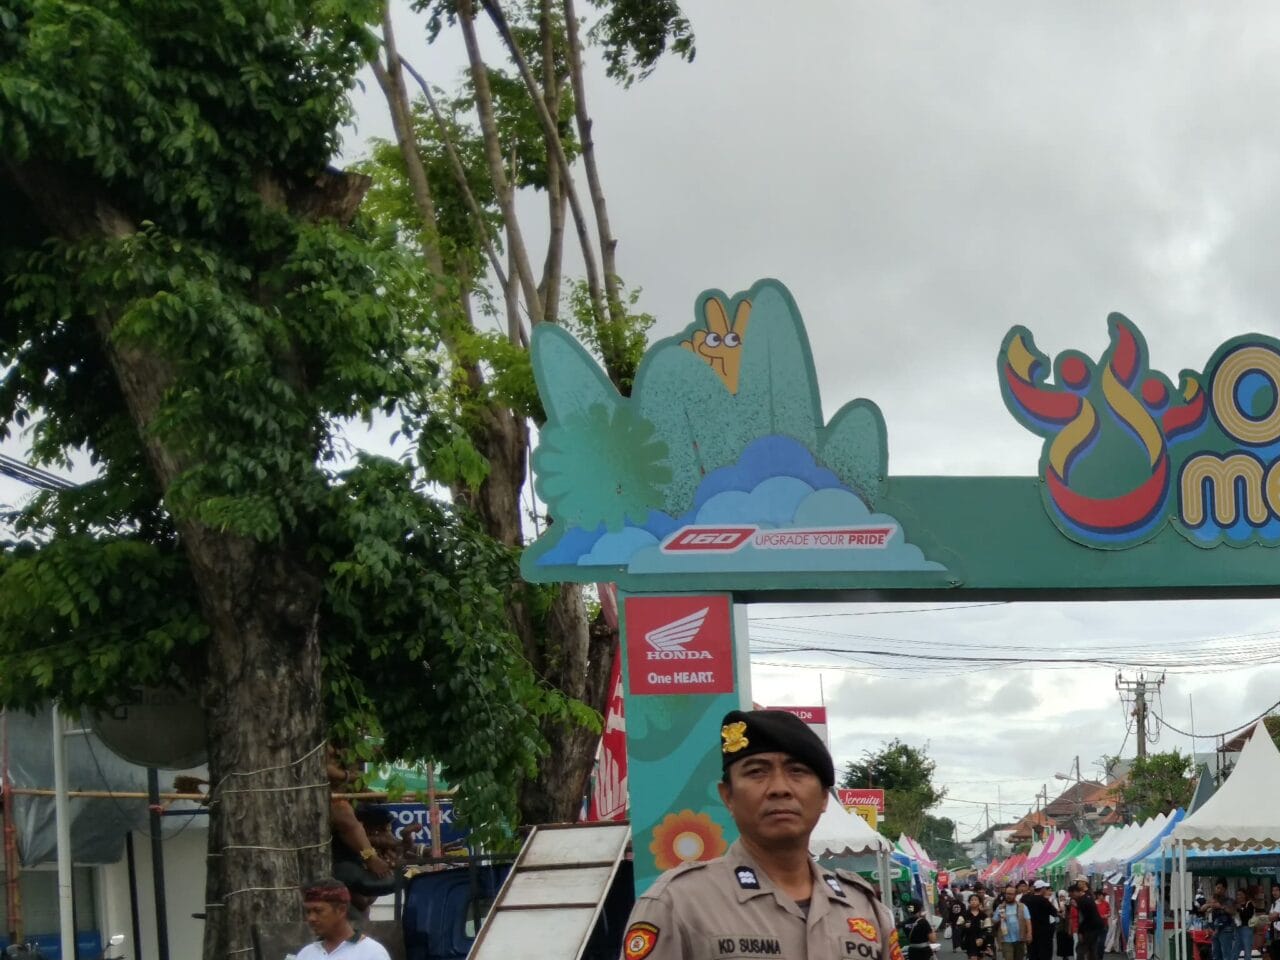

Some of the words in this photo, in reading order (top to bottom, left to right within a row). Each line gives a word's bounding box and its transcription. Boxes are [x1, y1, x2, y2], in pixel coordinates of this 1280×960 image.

[680, 533, 737, 545] 160
[755, 534, 809, 546] UPGRADE
[814, 534, 845, 545] YOUR
[848, 533, 885, 545] PRIDE
[646, 651, 714, 660] HONDA
[647, 672, 672, 684] One
[673, 671, 715, 683] HEART.
[842, 791, 882, 809] Serenity
[718, 939, 736, 954] KD
[739, 938, 782, 955] SUSANA
